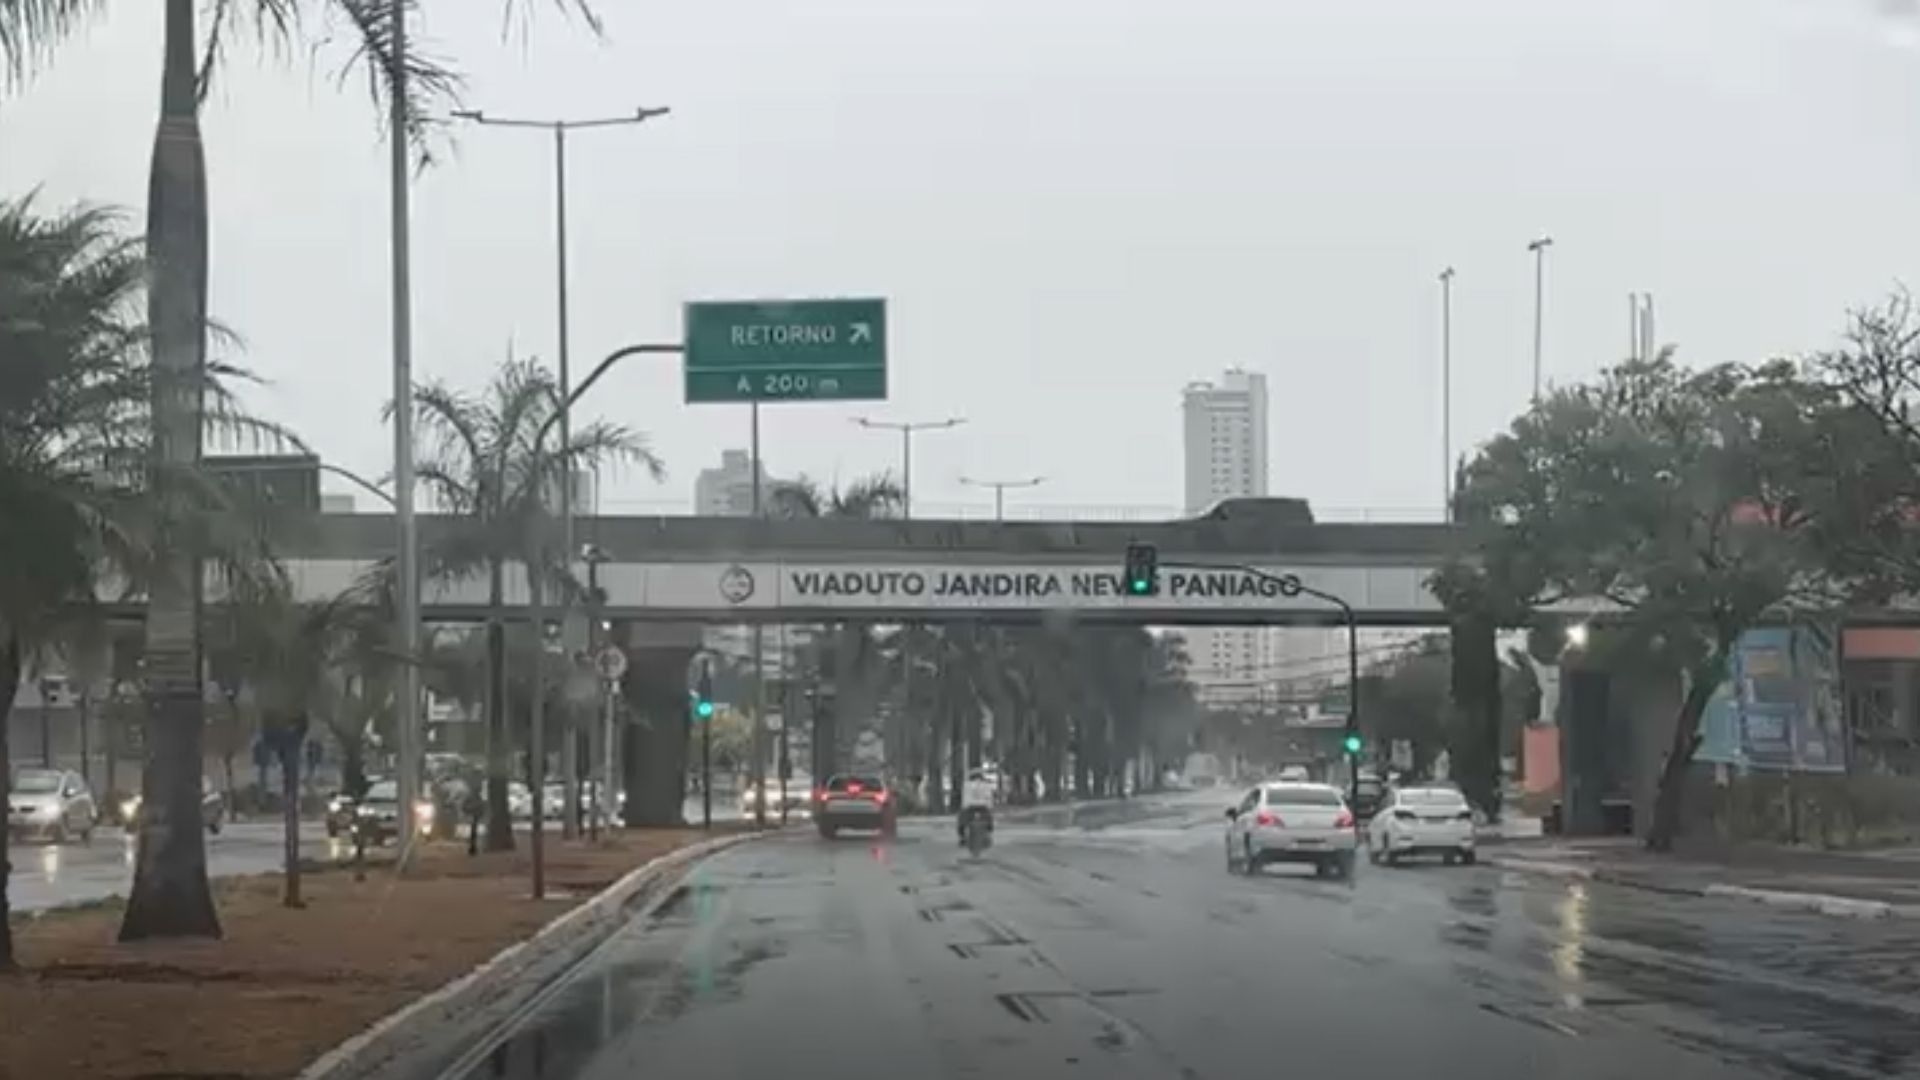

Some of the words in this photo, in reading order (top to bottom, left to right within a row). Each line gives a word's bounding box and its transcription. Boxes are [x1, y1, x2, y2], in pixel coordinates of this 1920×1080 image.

[730, 325, 836, 345] RETORNO
[736, 376, 751, 393] A
[764, 374, 808, 394] 200
[792, 573, 926, 595] VIADUTO
[933, 573, 1061, 597] JANDIRA
[1169, 574, 1301, 598] PANIAGO
